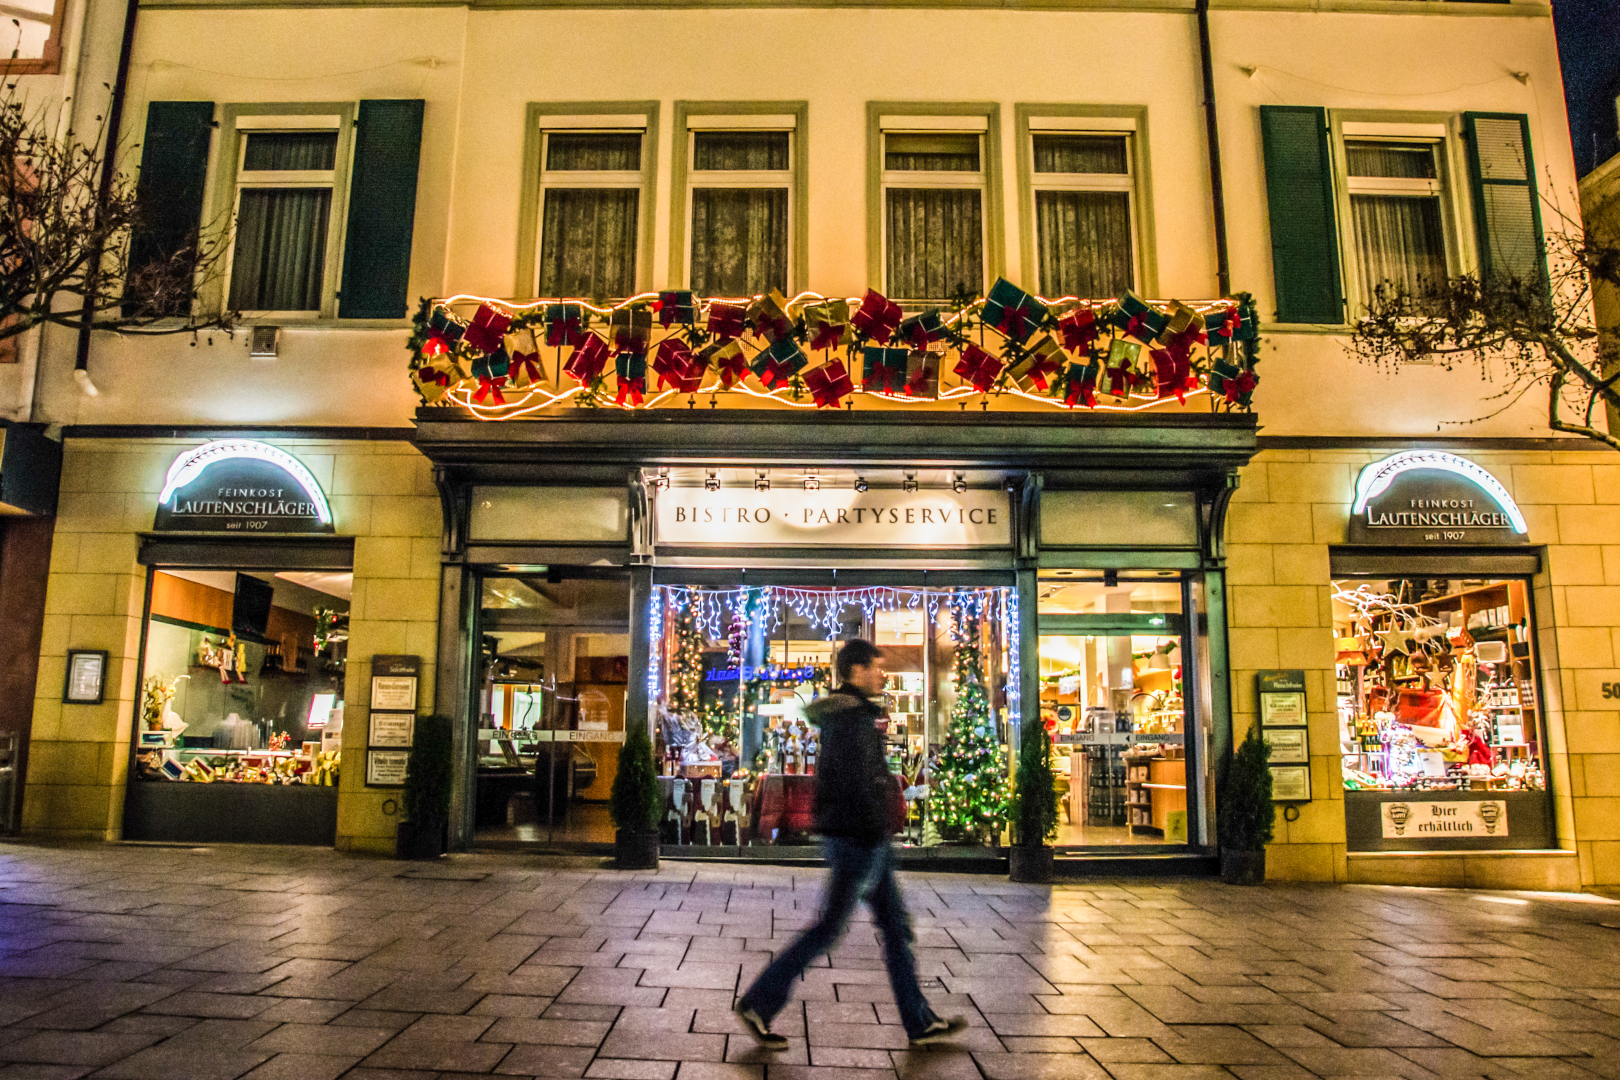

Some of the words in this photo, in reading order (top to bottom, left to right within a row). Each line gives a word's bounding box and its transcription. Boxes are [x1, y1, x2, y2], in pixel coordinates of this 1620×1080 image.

[218, 488, 284, 498] FEINKOST
[171, 494, 317, 515] LAUTENSCHLÄGER
[1410, 499, 1474, 508] FEINKOST
[675, 506, 771, 524] BISTRO
[803, 507, 998, 525] PARTYSERVICE
[1366, 505, 1511, 526] LAUTENSCHLÄGER
[226, 521, 242, 530] seit
[245, 520, 268, 530] 1907
[1424, 532, 1440, 541] seit
[1443, 531, 1466, 541] 1907
[1601, 682, 1620, 700] 50
[492, 730, 538, 740] EINGANG
[569, 731, 616, 741] EINGANG
[1060, 734, 1095, 742] EINGANG
[1135, 733, 1170, 742] EINGANG
[1431, 804, 1458, 819] Hier
[1418, 820, 1473, 833] erhältlich
